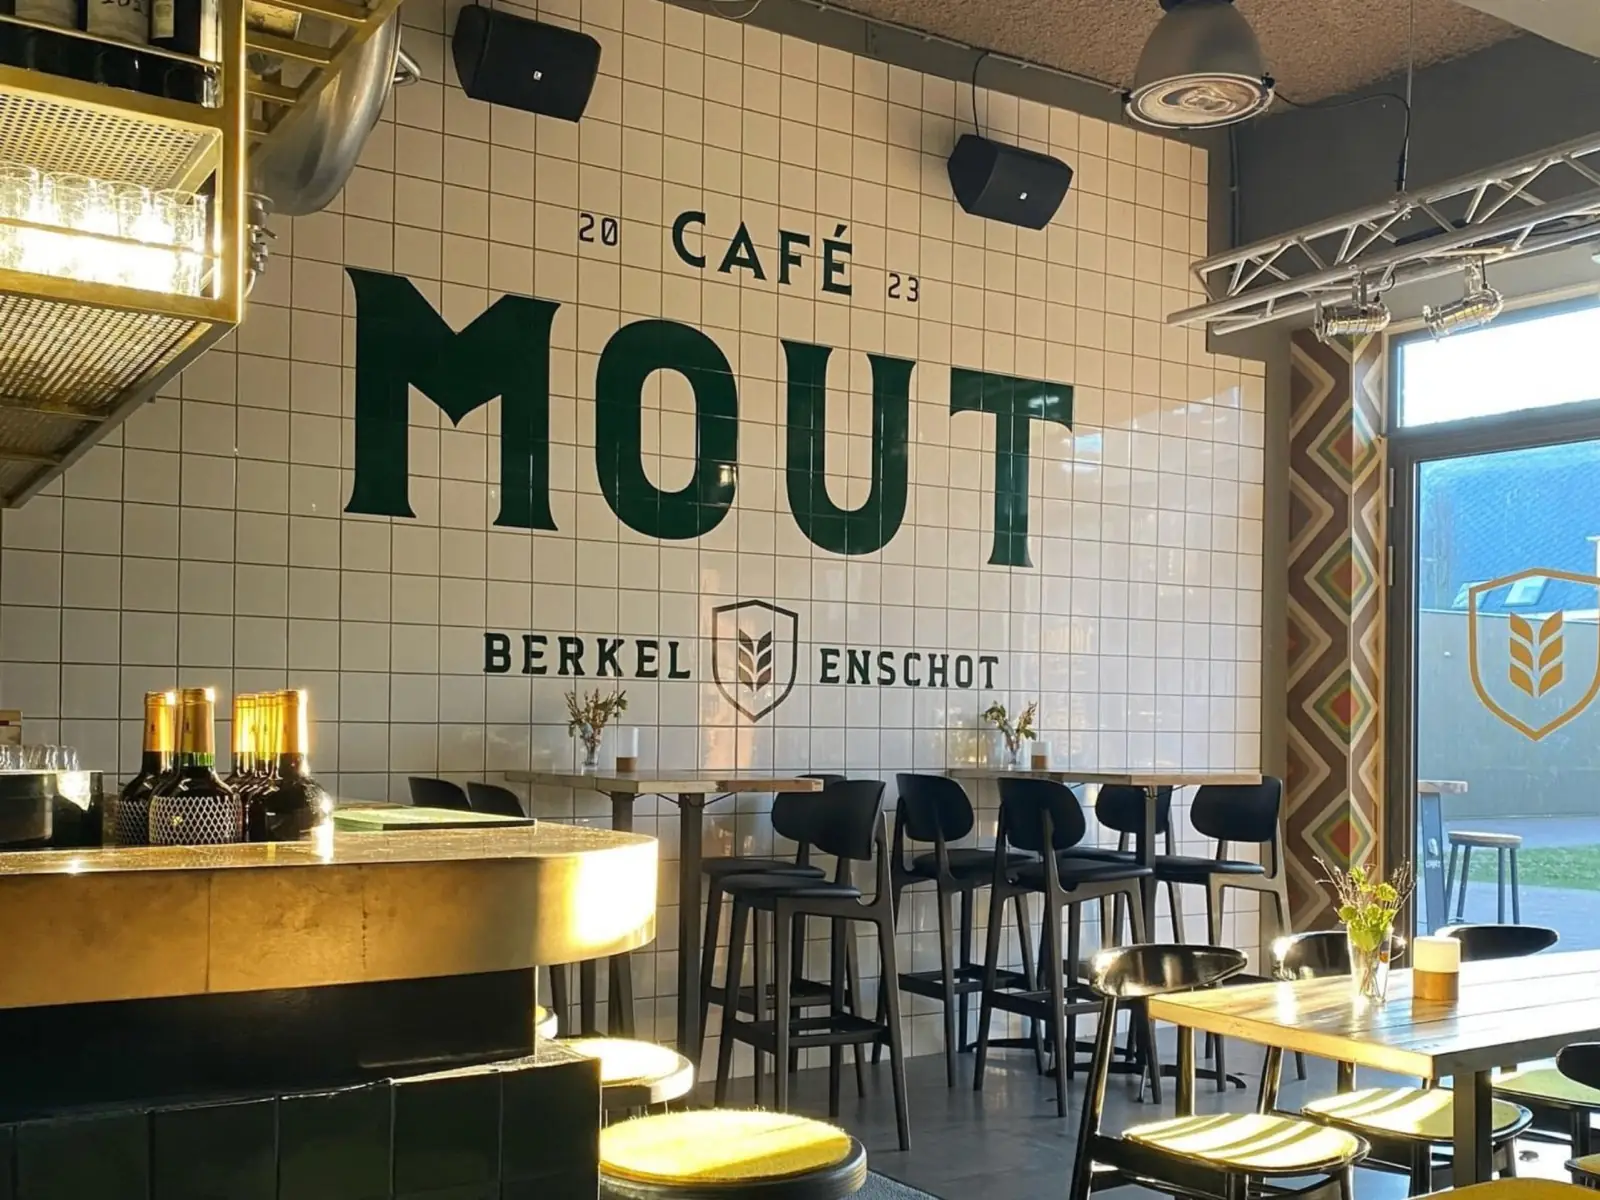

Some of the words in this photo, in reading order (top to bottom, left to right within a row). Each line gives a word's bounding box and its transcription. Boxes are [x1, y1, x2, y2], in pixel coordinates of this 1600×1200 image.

[578, 212, 618, 247] 20
[672, 210, 853, 297] CAFÉ
[888, 272, 919, 302] 23
[343, 266, 1074, 568] MOUT
[484, 631, 691, 679] BERKEL
[820, 648, 999, 689] ENSCHOT
